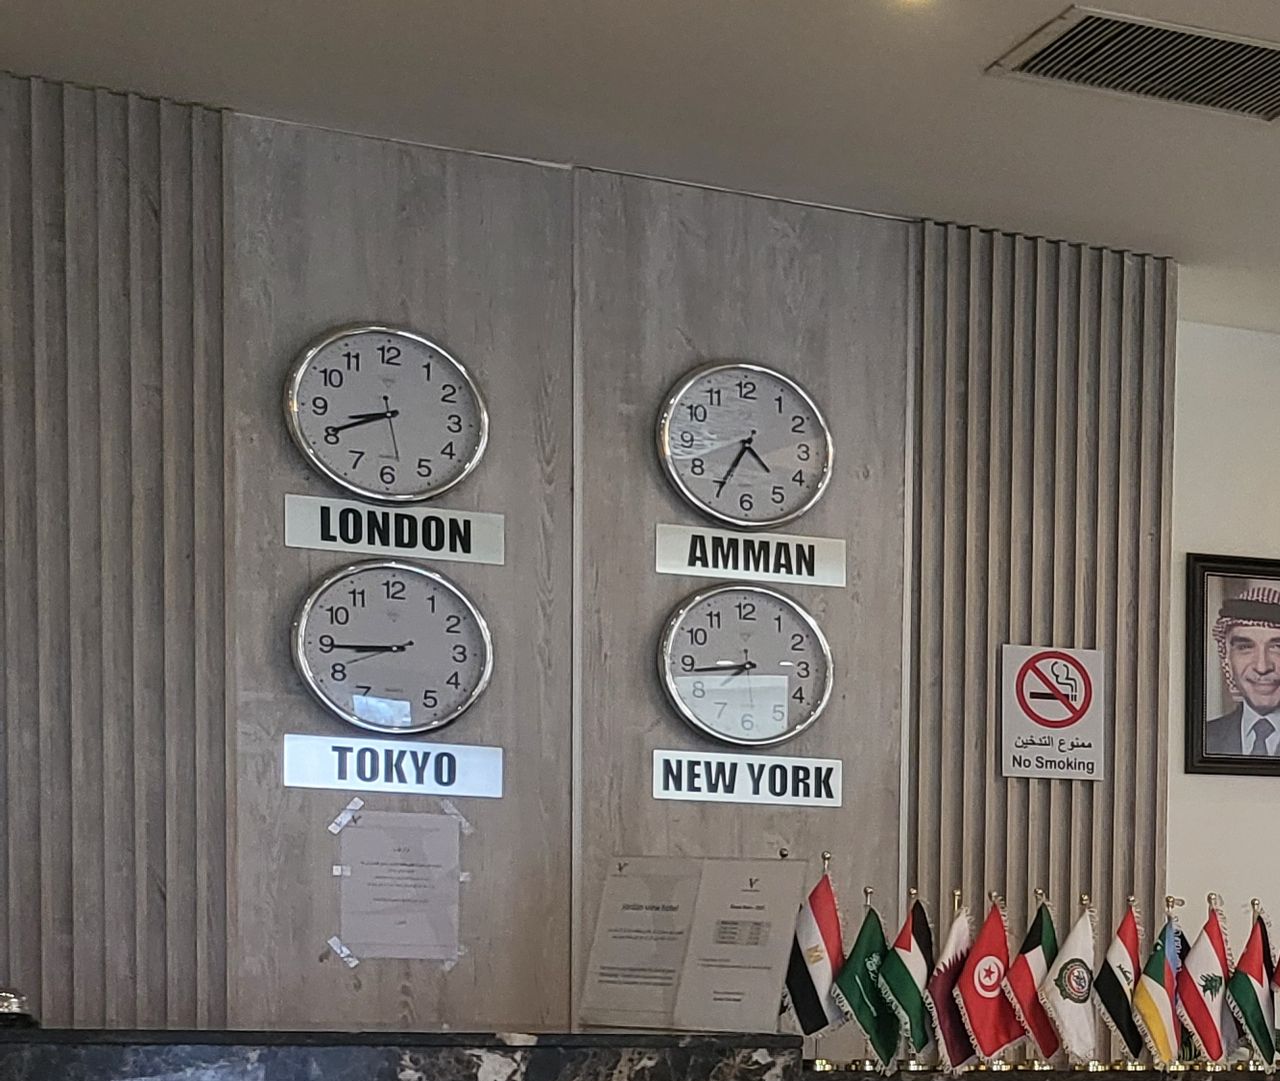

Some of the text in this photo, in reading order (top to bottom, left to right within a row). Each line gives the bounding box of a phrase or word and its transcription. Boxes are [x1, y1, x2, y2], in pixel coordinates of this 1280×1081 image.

[343, 352, 360, 371] 11
[377, 346, 401, 366] 12
[320, 369, 343, 388] 10
[423, 363, 431, 381] 1
[441, 385, 456, 403] 2
[706, 388, 721, 406] 11
[736, 382, 757, 400] 12
[312, 397, 328, 415] 9
[687, 405, 707, 422] 10
[775, 396, 782, 413] 1
[447, 415, 462, 433] 3
[791, 416, 805, 433] 2
[324, 426, 340, 444] 8
[681, 431, 694, 448] 9
[441, 442, 456, 459] 4
[797, 444, 810, 461] 3
[349, 451, 365, 469] 7
[417, 459, 432, 477] 5
[691, 458, 704, 475] 8
[380, 465, 396, 484] 6
[792, 470, 805, 486] 4
[713, 479, 726, 498] 7
[772, 486, 784, 503] 5
[739, 494, 753, 511] 6
[320, 505, 472, 554] LONDON
[687, 534, 815, 577] AMMAN
[348, 589, 366, 607] 11
[382, 581, 406, 600] 12
[427, 596, 435, 613] 1
[734, 603, 756, 620] 12
[326, 606, 348, 625] 10
[706, 611, 720, 628] 11
[774, 616, 782, 632] 1
[446, 616, 461, 634] 2
[319, 635, 334, 653] 9
[687, 628, 707, 645] 10
[791, 634, 804, 651] 2
[452, 645, 467, 663] 3
[331, 663, 346, 681] 8
[681, 655, 694, 672] 9
[797, 662, 809, 678] 3
[446, 672, 460, 689] 4
[692, 681, 705, 698] 8
[423, 690, 437, 708] 5
[792, 687, 805, 703] 4
[714, 702, 727, 719] 7
[772, 705, 785, 721] 5
[741, 714, 754, 730] 6
[1014, 735, 1092, 752] ممنوع التدخين
[331, 745, 457, 787] TOKYO
[1012, 754, 1095, 774] No Smoking
[662, 758, 835, 799] NEW YORK
